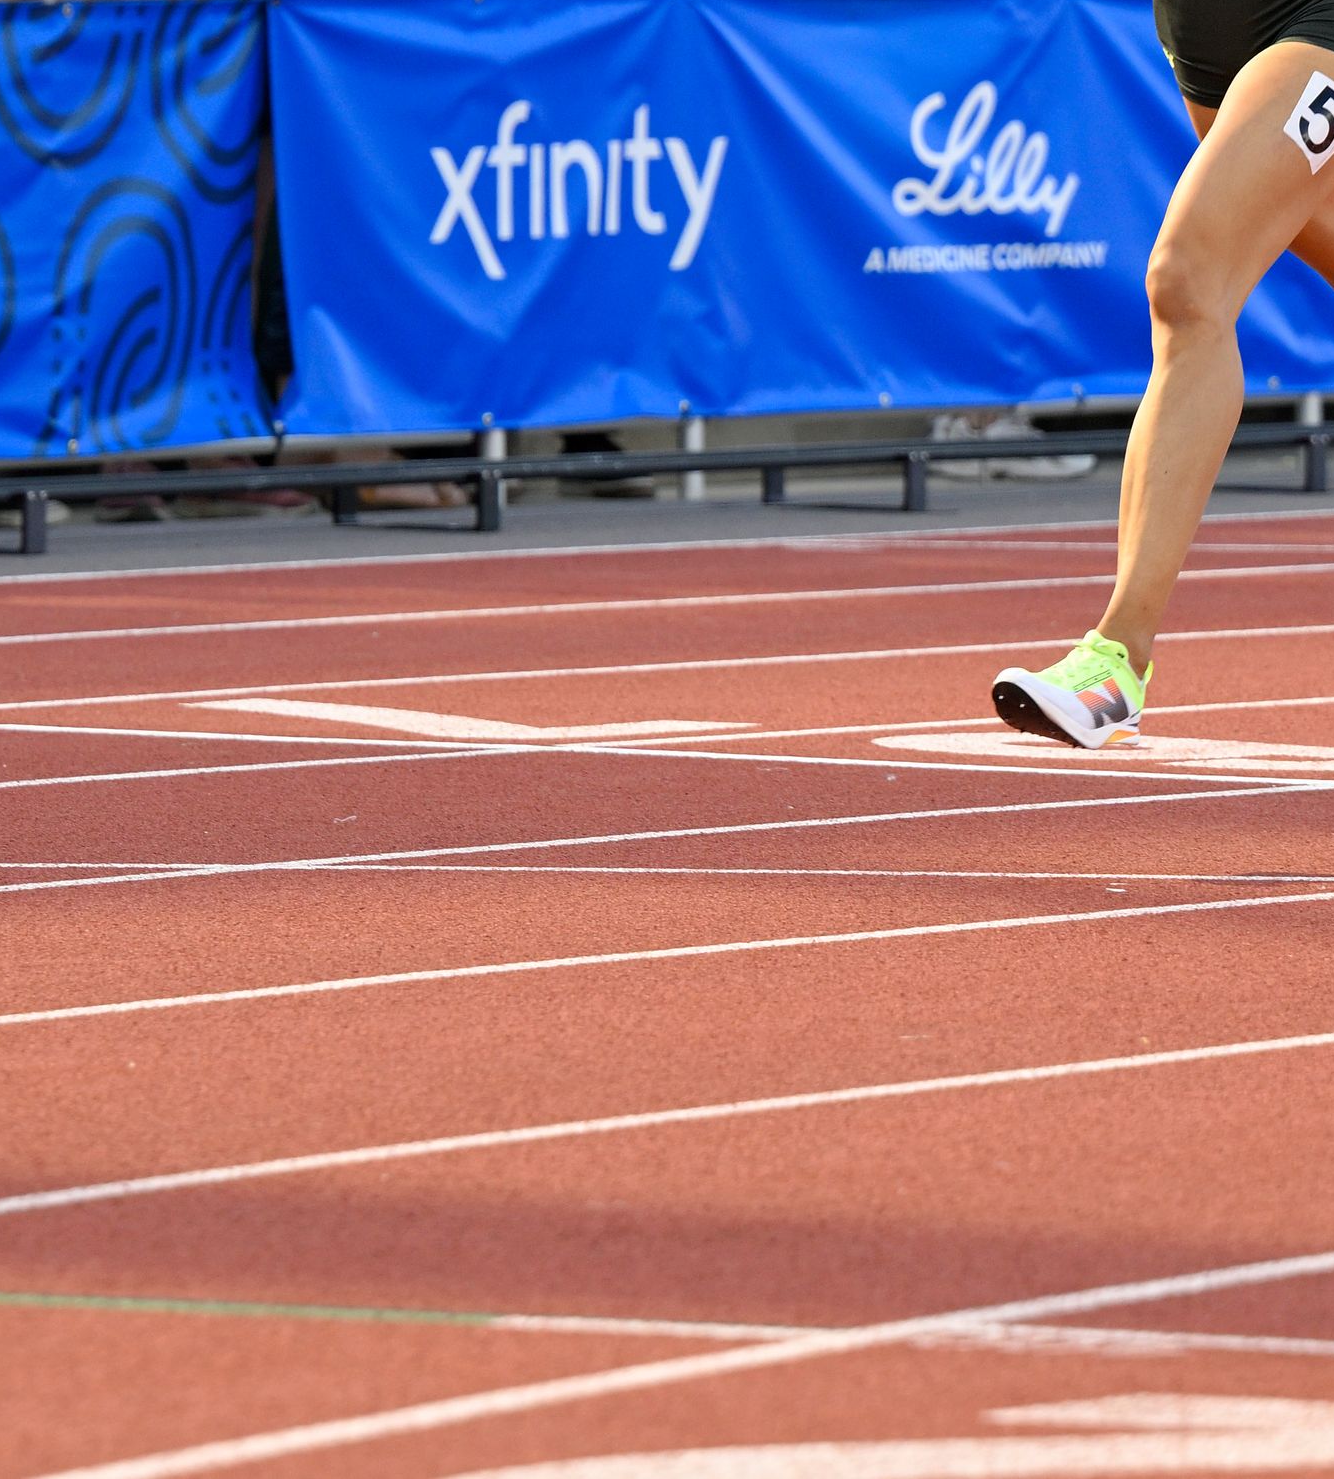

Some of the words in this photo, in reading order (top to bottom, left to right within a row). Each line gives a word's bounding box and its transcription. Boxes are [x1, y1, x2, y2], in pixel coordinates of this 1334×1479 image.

[428, 100, 729, 281] xfinity
[892, 80, 1080, 237] Lilly
[863, 246, 885, 273] A
[886, 243, 992, 273] MEDICINE
[992, 240, 1108, 271] COMPANY
[182, 698, 759, 741] 7
